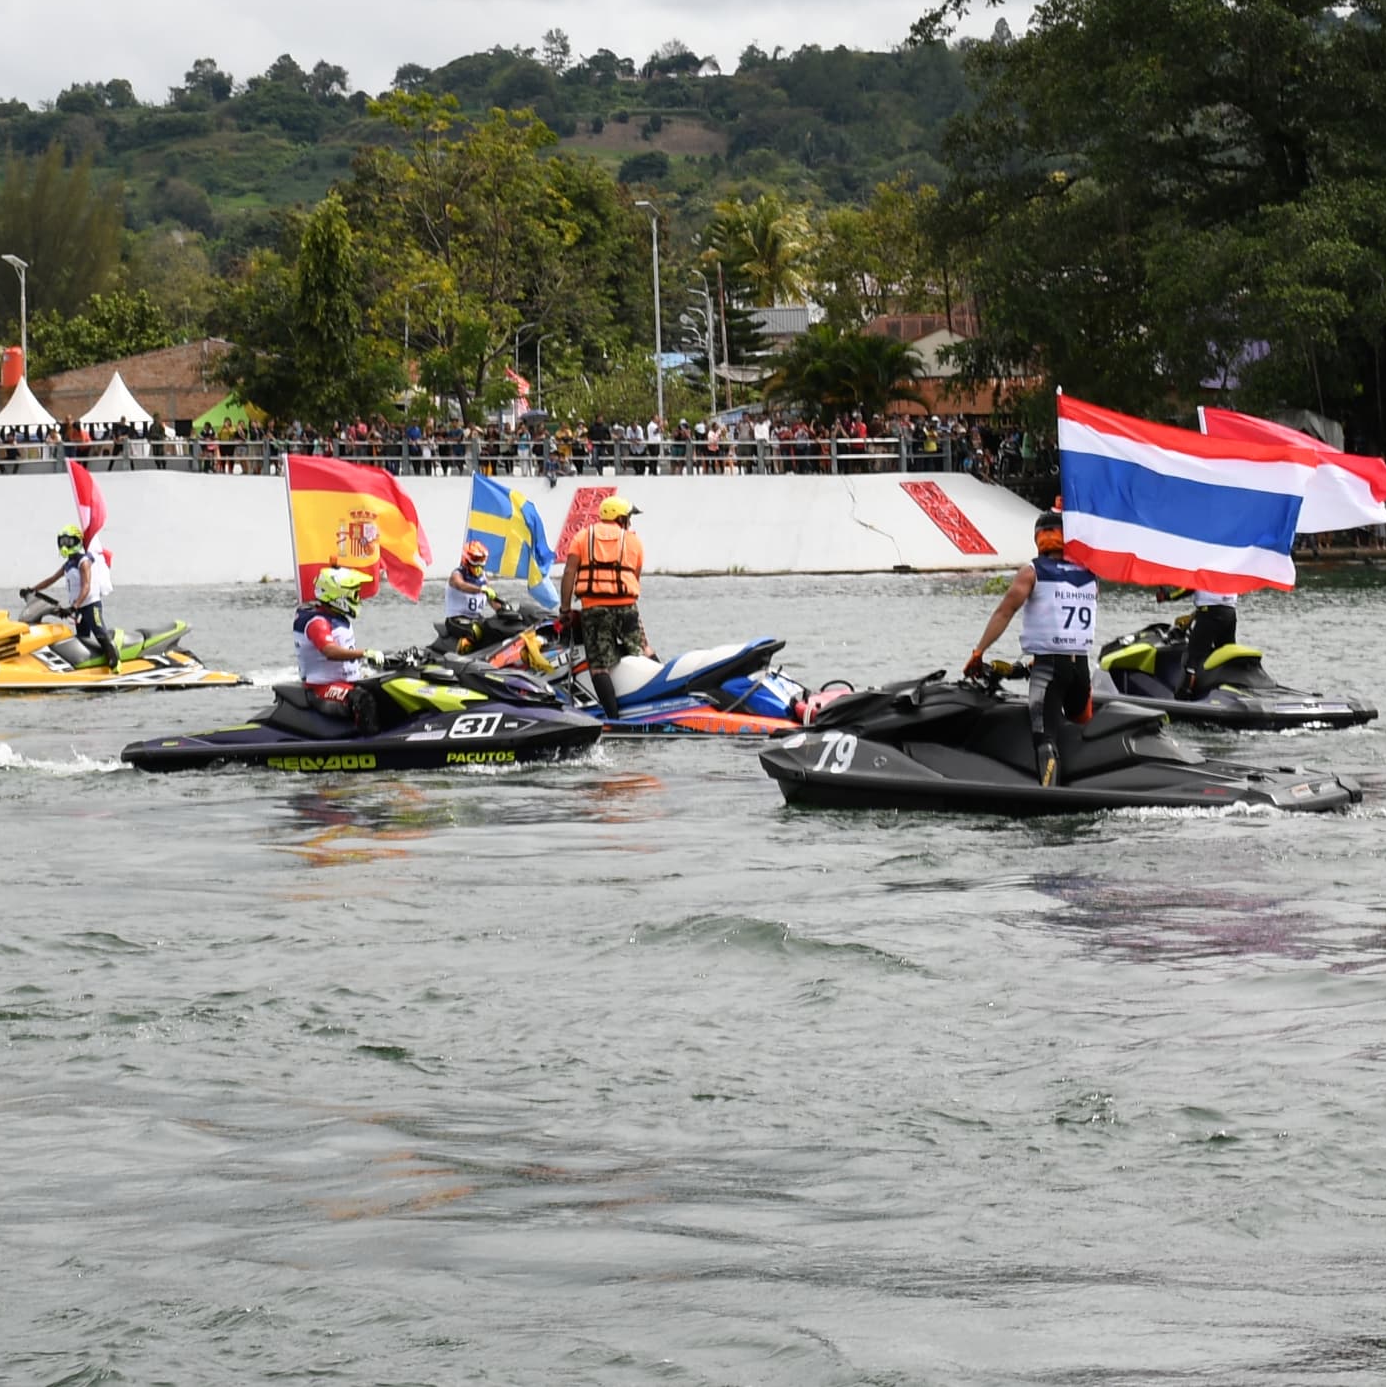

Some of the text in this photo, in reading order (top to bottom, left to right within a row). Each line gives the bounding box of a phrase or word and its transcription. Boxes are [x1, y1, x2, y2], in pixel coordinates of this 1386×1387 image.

[468, 596, 486, 612] 84
[1061, 605, 1092, 630] 79
[452, 715, 499, 736] 31
[447, 751, 515, 763] PACUTOS
[813, 733, 858, 774] 79
